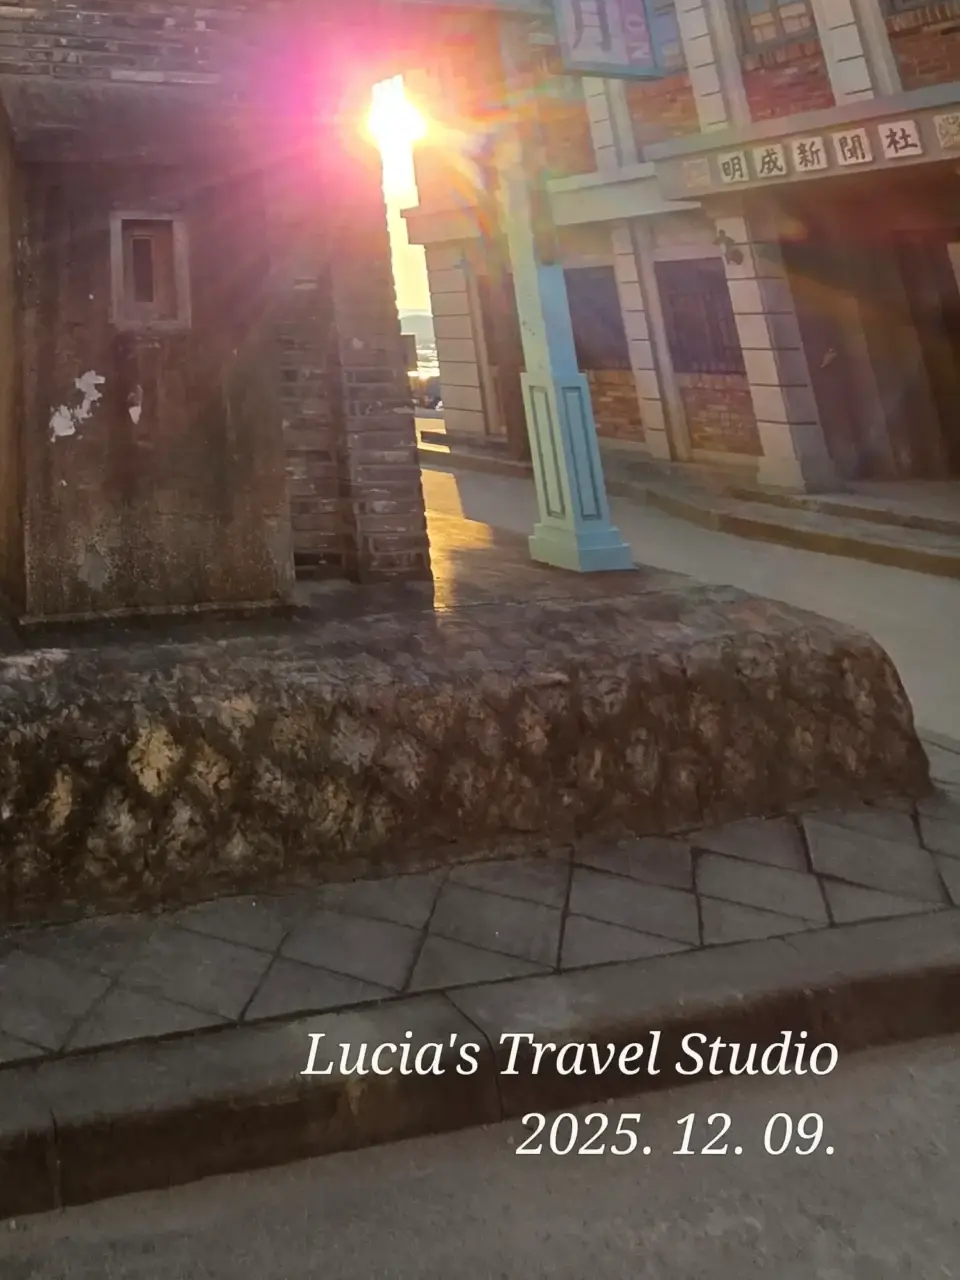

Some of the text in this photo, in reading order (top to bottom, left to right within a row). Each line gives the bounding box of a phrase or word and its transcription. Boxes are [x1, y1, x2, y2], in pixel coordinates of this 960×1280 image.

[721, 127, 919, 181] 明成新聞社
